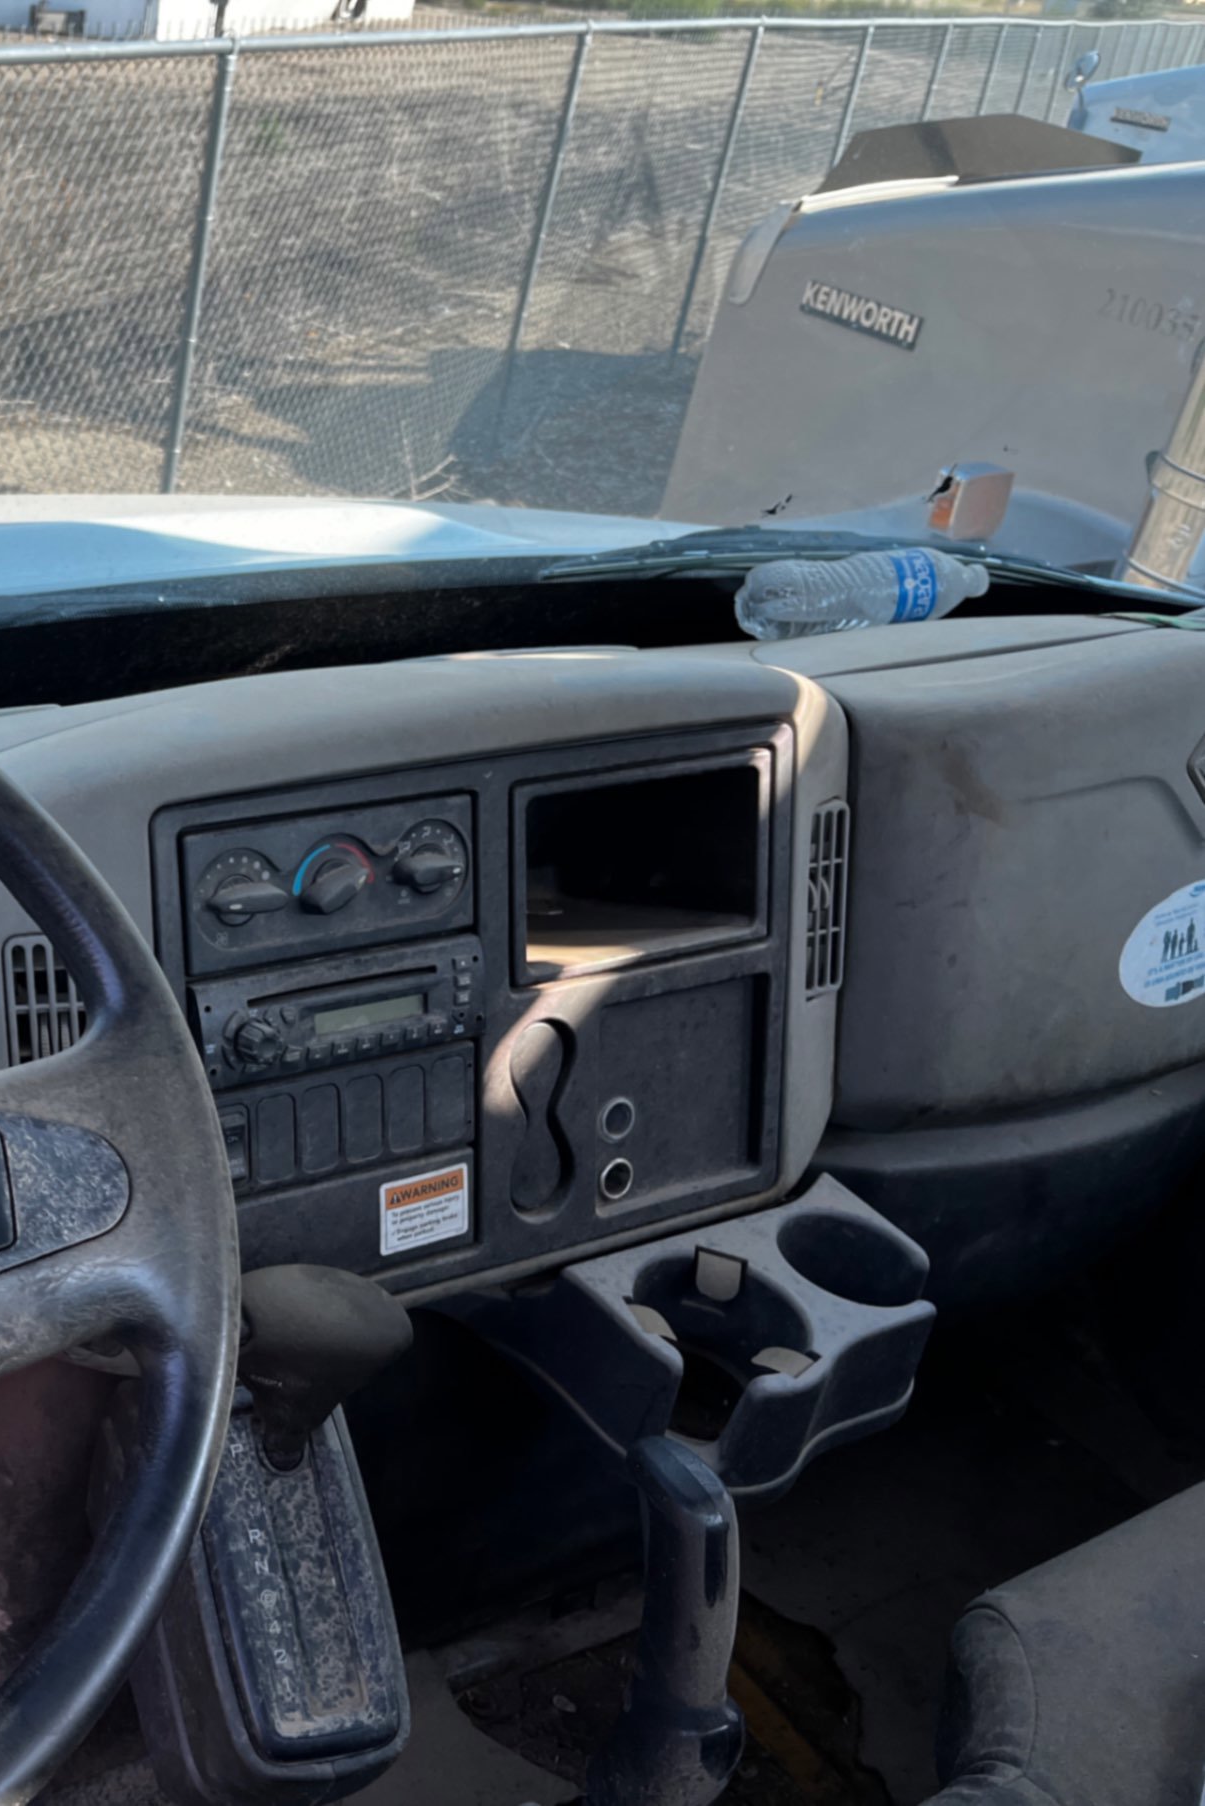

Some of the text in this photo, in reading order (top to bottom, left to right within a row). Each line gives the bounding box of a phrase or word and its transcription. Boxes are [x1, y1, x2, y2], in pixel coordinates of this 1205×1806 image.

[802, 280, 919, 343] KENWORTH
[400, 1176, 459, 1200] WARNING
[230, 1443, 243, 1458] P
[254, 1560, 269, 1575] N
[274, 1648, 287, 1664] 2
